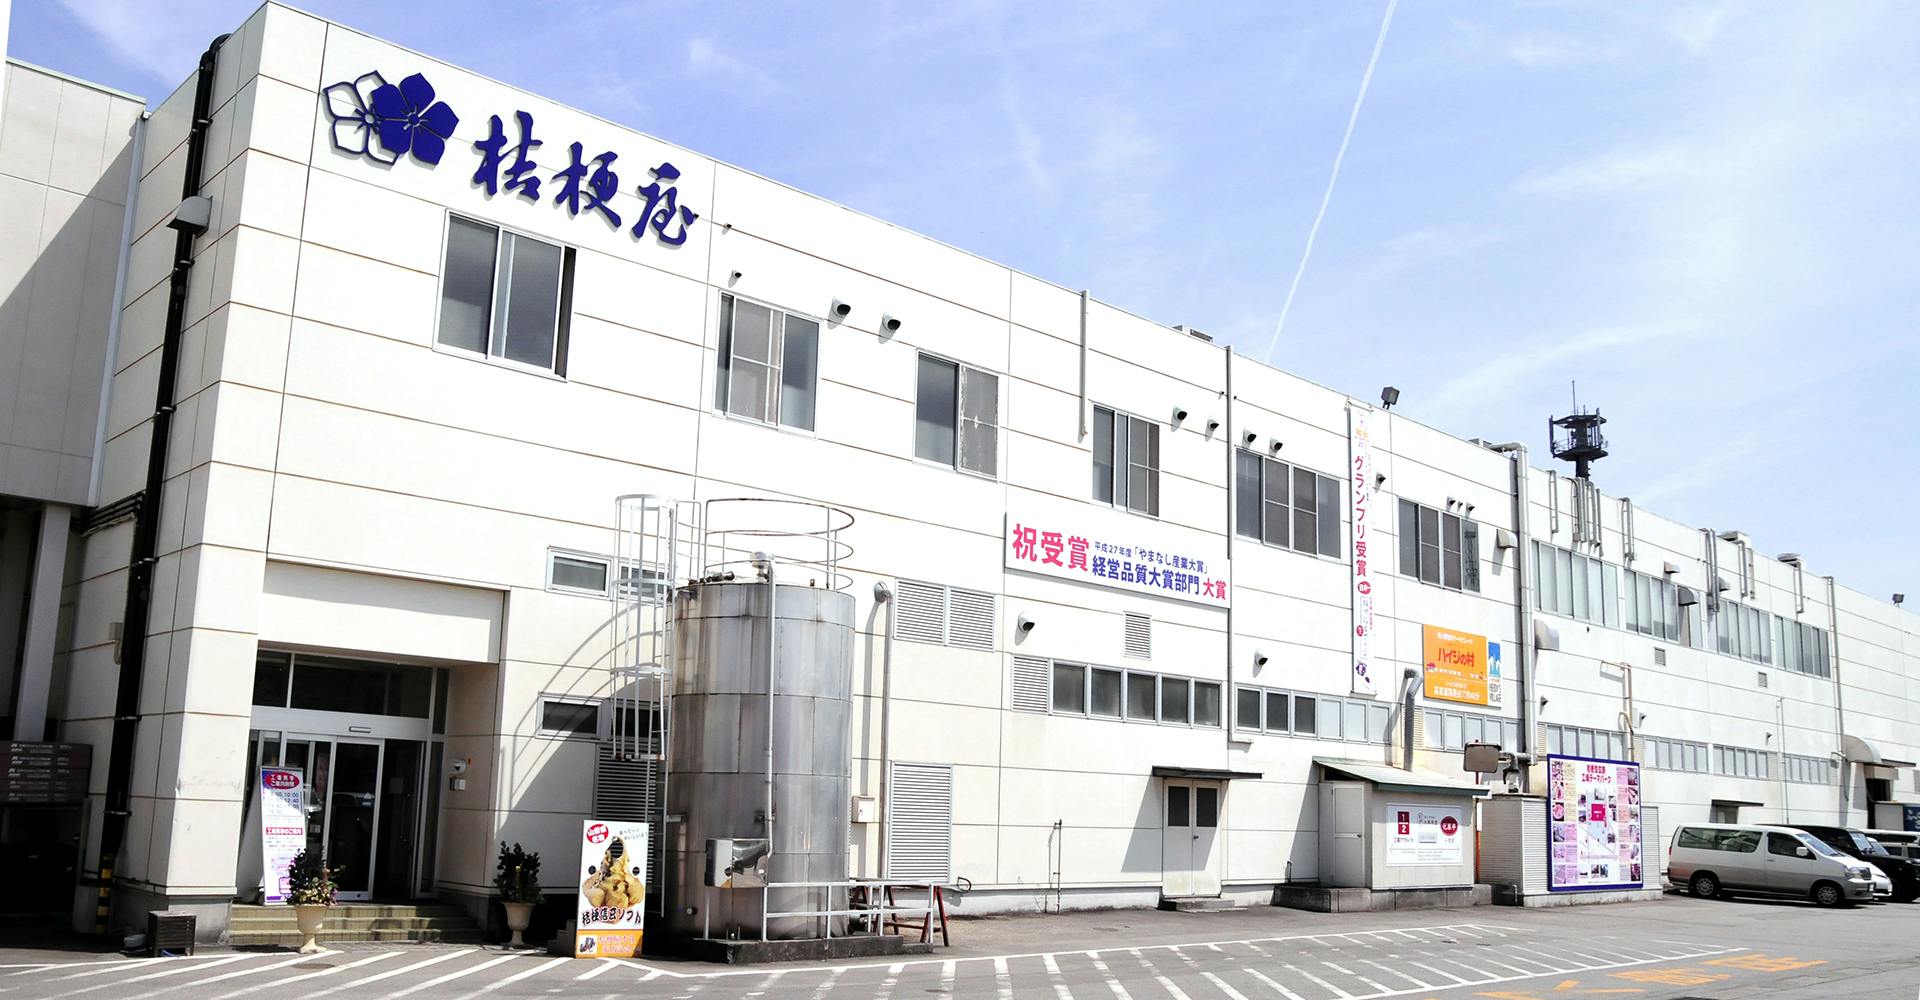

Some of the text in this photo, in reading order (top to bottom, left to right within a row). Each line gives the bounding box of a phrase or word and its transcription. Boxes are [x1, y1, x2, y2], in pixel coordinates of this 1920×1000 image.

[472, 110, 699, 246] 桔梗屋
[1012, 523, 1090, 572] 祝受賞
[1092, 555, 1227, 600] 経営品質大賞部門 大賞
[1438, 647, 1475, 668] ハイジの村
